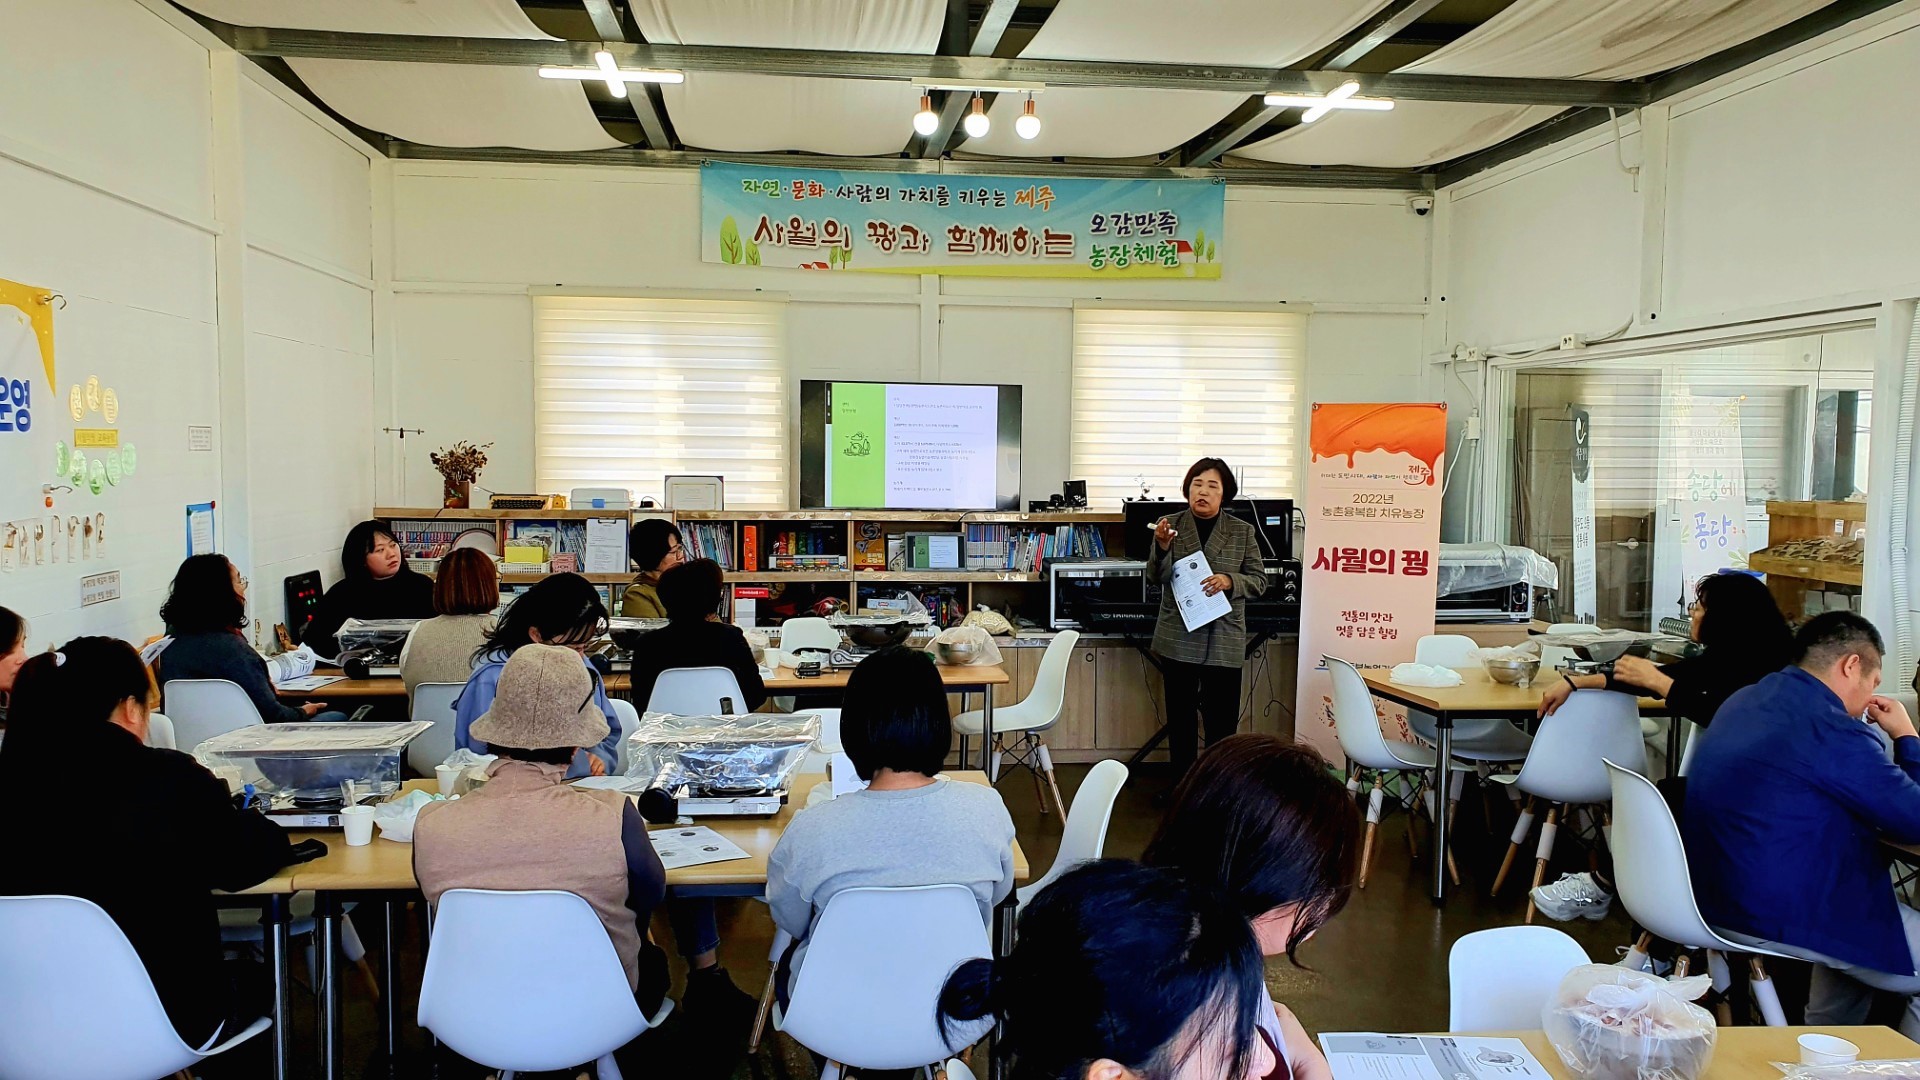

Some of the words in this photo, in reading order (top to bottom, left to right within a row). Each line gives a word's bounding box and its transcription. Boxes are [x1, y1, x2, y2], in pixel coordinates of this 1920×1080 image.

[898, 188, 950, 208] 가치를
[958, 189, 1007, 208] 키우는
[1014, 184, 1057, 211] 제주
[1089, 209, 1179, 235] 오감만족
[753, 214, 851, 251] 사월의
[867, 220, 930, 254] 꿩과
[946, 223, 1075, 257] 함께하는
[1087, 239, 1180, 269] 농장체험
[1408, 464, 1431, 477] 제주
[1352, 493, 1394, 505] 2022년
[1322, 506, 1377, 518] 농촌융복합
[1380, 507, 1425, 519] 치유농장
[1694, 512, 1732, 550] 퐁당
[1311, 547, 1395, 575] 사월의
[1401, 550, 1429, 576] 꿩
[1341, 610, 1369, 623] 전통의
[1371, 611, 1394, 624] 맛과
[1335, 625, 1354, 639] 멋을
[1356, 626, 1376, 639] 담은
[1378, 626, 1399, 640] 힐링
